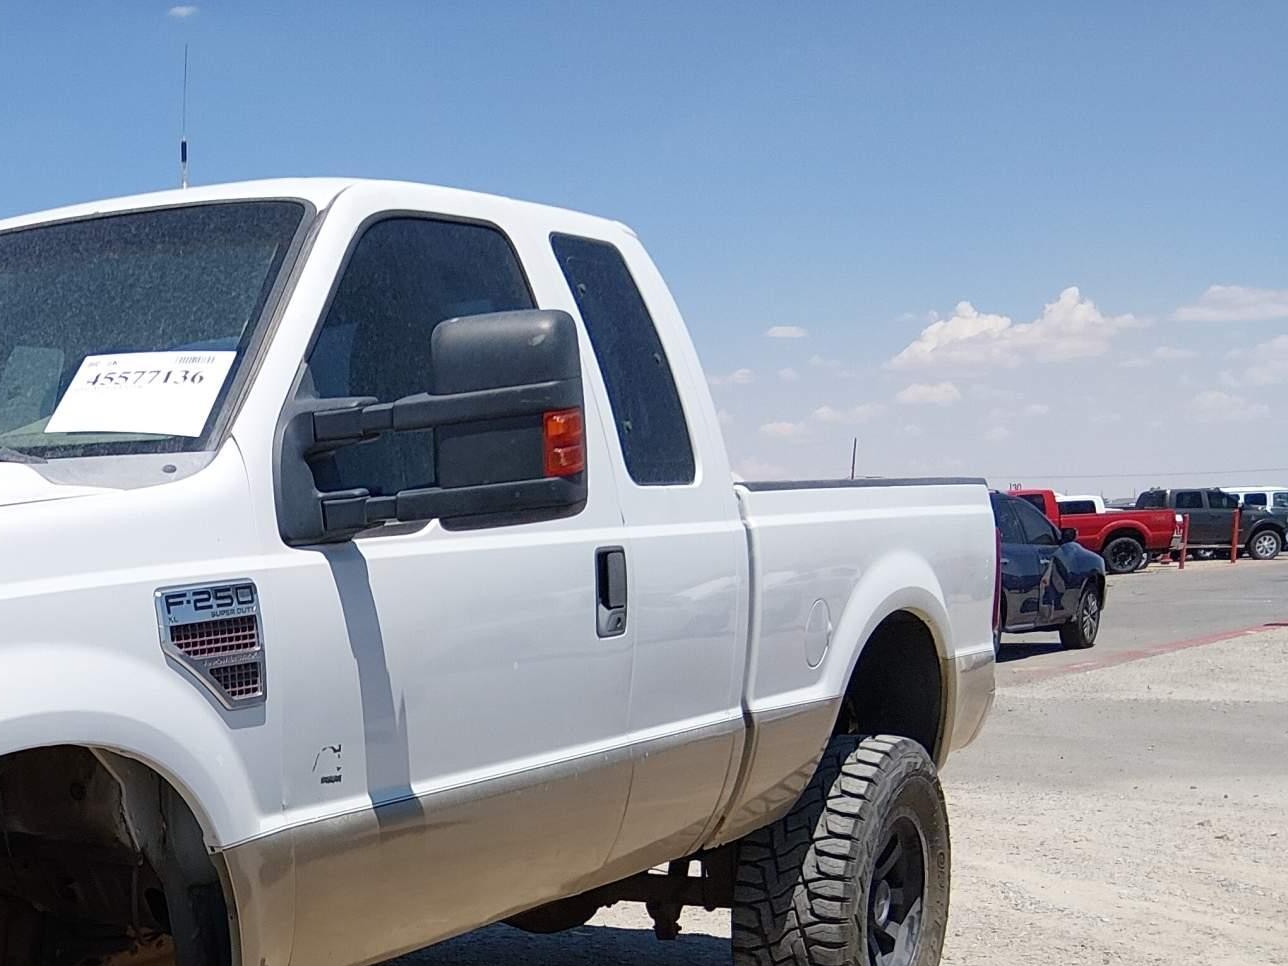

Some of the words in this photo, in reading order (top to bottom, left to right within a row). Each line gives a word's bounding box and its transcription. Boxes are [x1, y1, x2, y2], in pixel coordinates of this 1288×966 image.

[87, 368, 205, 386] 45577136
[165, 586, 256, 614] F-250
[211, 608, 236, 618] SUPER
[237, 605, 257, 616] DUTY
